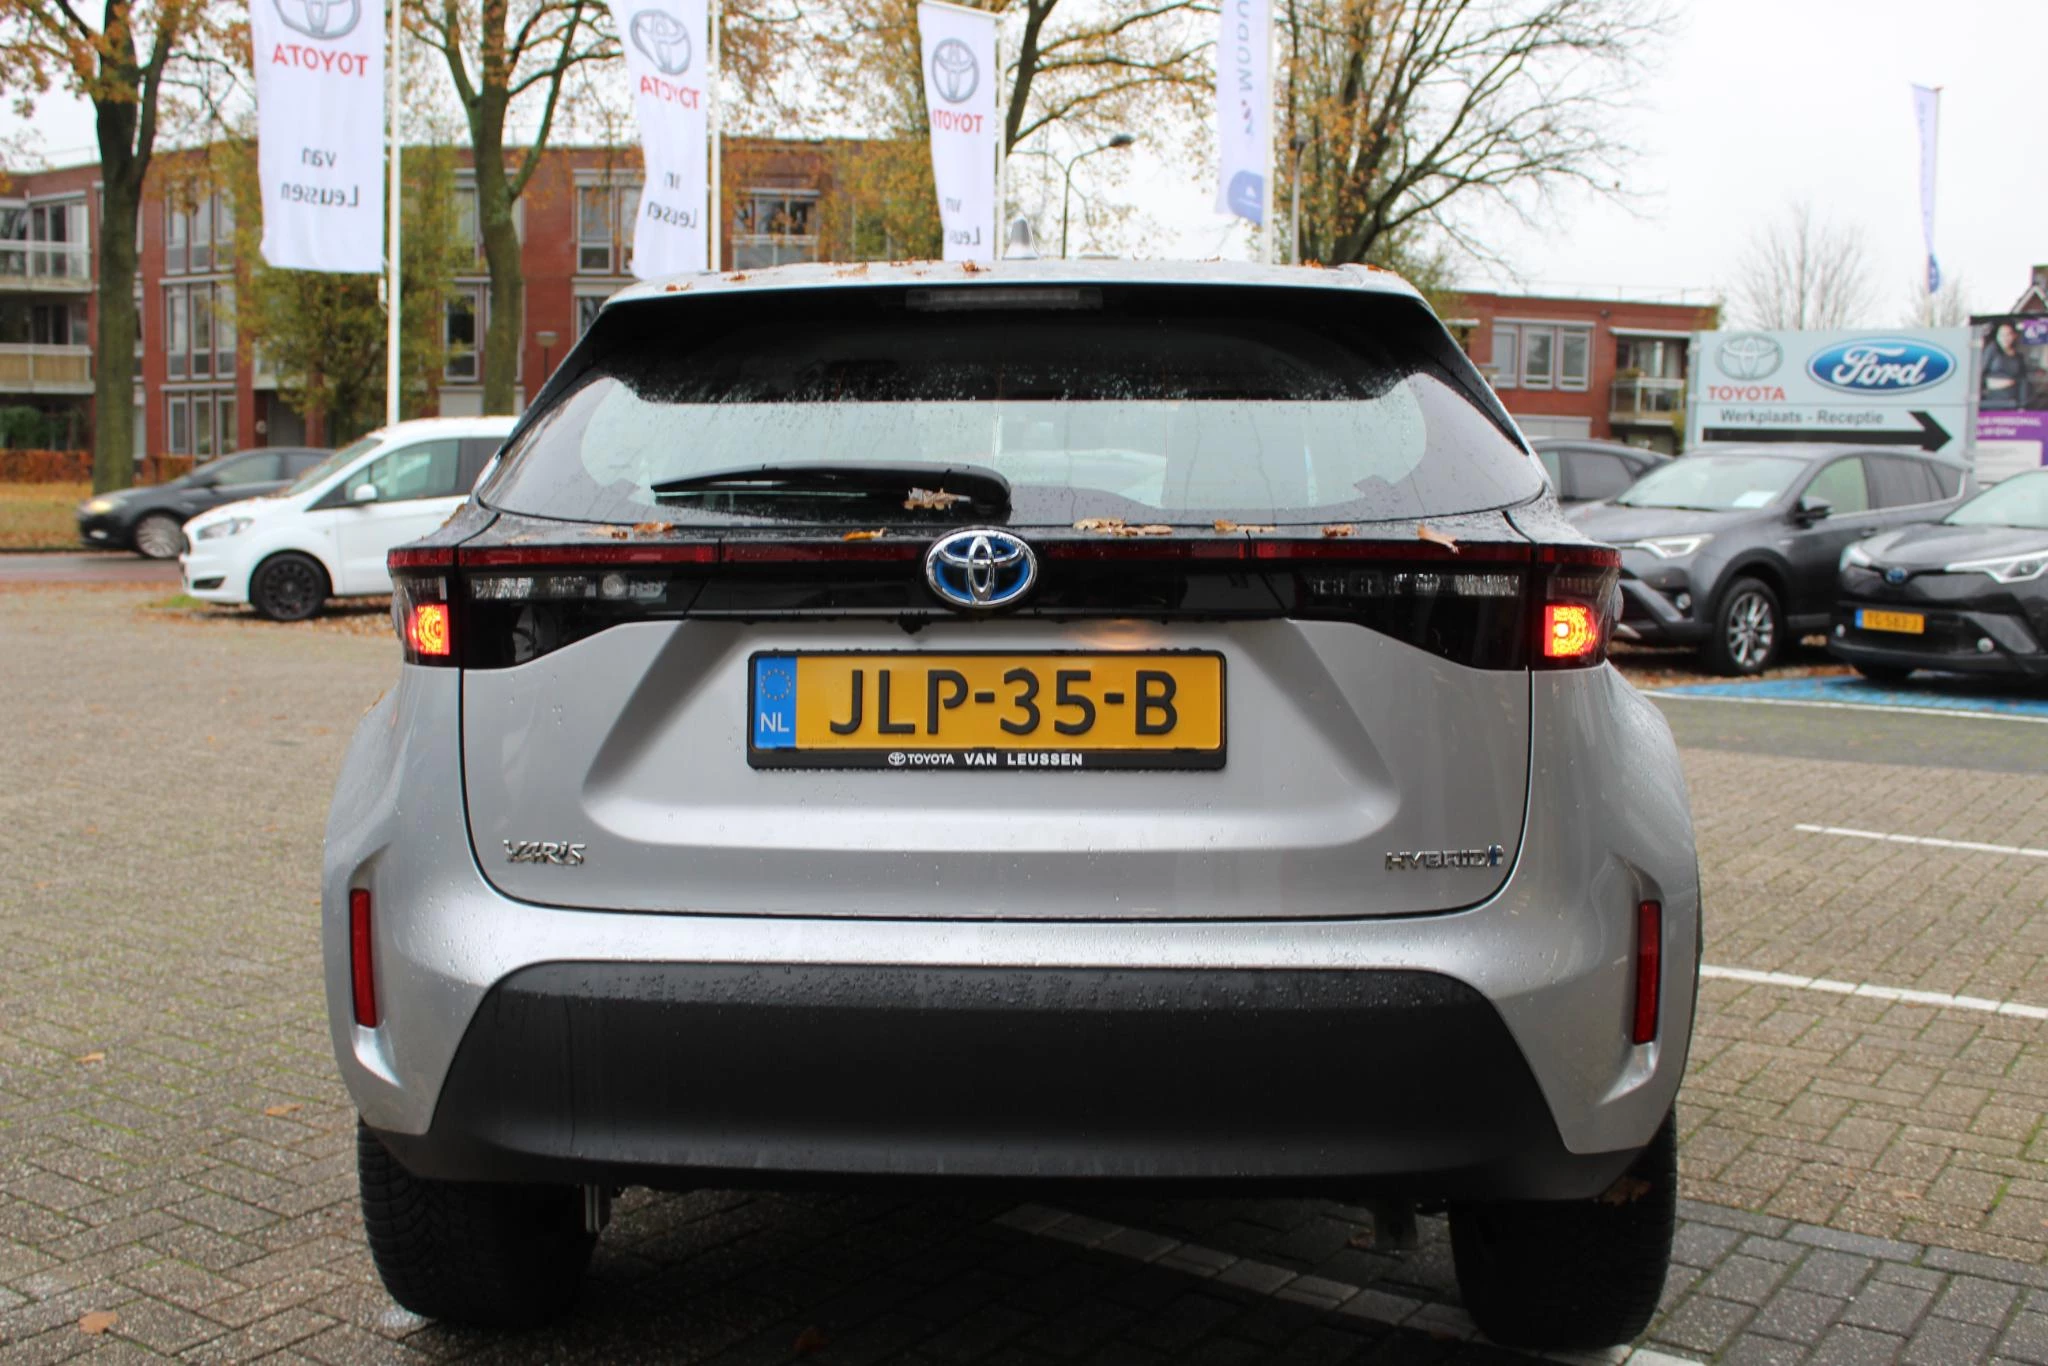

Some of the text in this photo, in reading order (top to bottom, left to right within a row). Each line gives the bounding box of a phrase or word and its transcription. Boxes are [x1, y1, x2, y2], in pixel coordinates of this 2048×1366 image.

[1831, 346, 1930, 386] Ford
[1708, 385, 1786, 401] TOYOTA
[1720, 409, 1802, 425] Werkplaats
[1817, 409, 1884, 424] Receptie
[829, 668, 1178, 736] JLP-35-B
[760, 713, 790, 733] NL
[907, 753, 1084, 766] TOYOTA VAN LEUSSEN
[503, 840, 586, 866] YARIS
[1385, 849, 1486, 870] HYBRID
